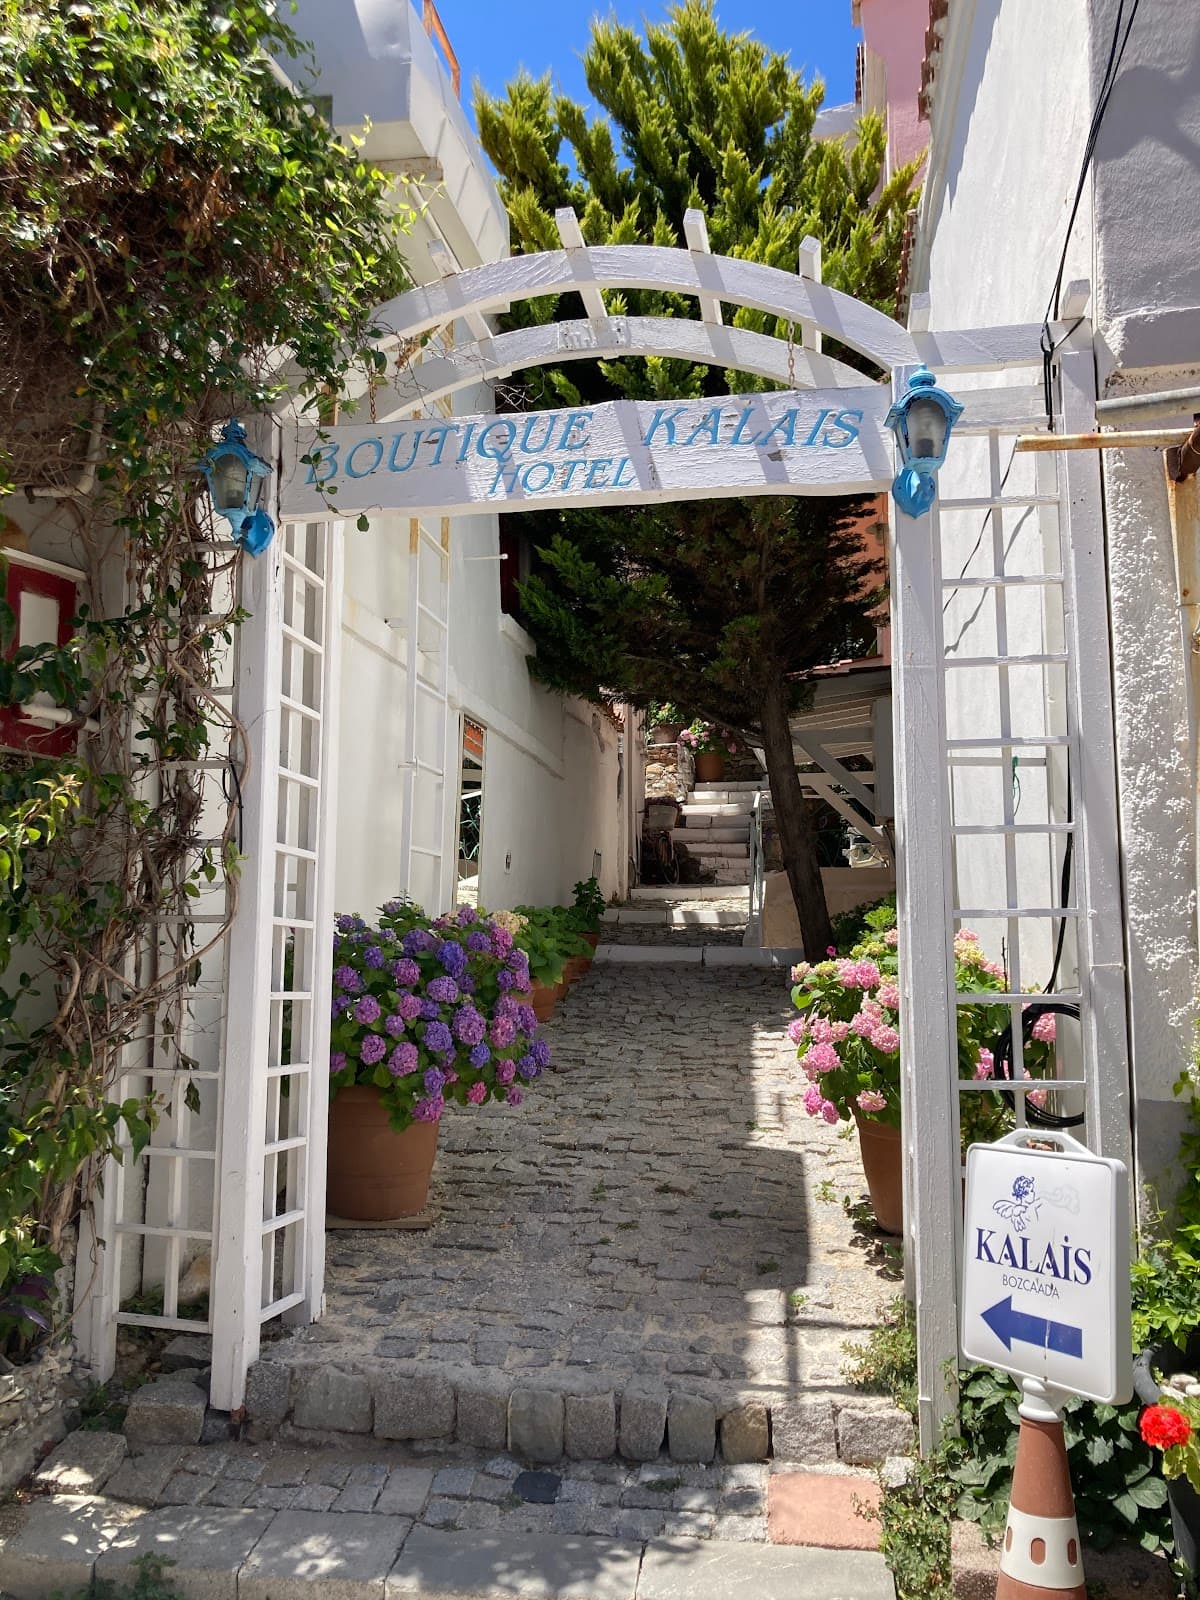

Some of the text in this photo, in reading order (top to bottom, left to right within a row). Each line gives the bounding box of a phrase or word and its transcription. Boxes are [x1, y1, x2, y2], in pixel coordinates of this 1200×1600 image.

[304, 407, 864, 484] BOUTIQUE KALAIS
[488, 458, 636, 495] HOTEL
[1002, 1274, 1060, 1299] BOZCAADA
